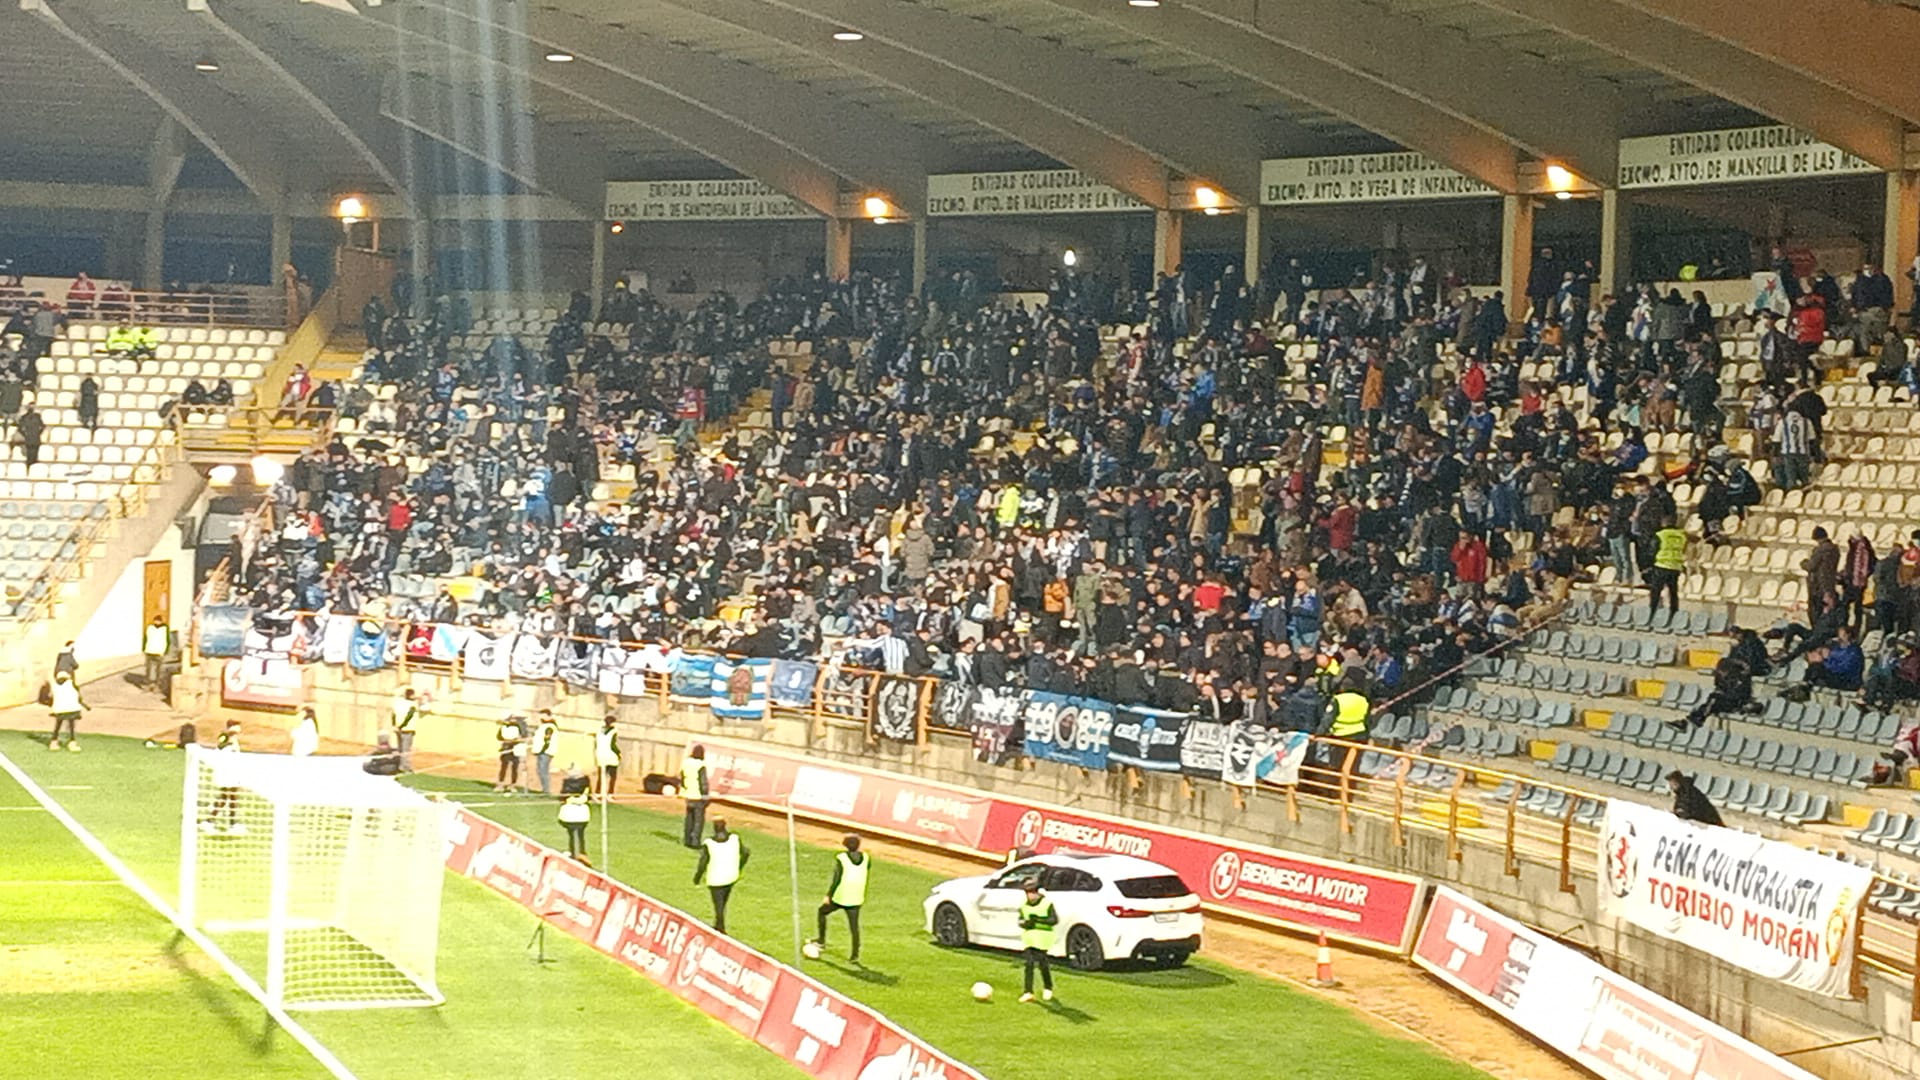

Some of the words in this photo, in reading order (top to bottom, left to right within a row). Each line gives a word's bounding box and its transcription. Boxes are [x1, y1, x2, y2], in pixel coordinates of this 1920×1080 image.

[1670, 134, 1720, 155] ENTIDAD
[1308, 158, 1354, 176] ENTIDAD
[1708, 159, 1721, 179] DE
[1727, 155, 1787, 177] MANSILLA
[1793, 153, 1808, 173] DE
[1814, 151, 1835, 171] LAS
[972, 175, 1015, 191] ENTIDAD
[1350, 180, 1363, 197] DE
[1368, 179, 1397, 196] VEGA
[1402, 178, 1415, 195] DE
[1007, 194, 1019, 211] DE
[1079, 192, 1092, 209] DE
[1096, 192, 1108, 208] LA
[1790, 423, 1800, 440] 9
[1042, 819, 1106, 850] BERNESGA
[1105, 831, 1152, 858] MOTOR
[1240, 860, 1315, 896] BERNESGA
[1314, 876, 1369, 907] MOTOR
[1702, 847, 1824, 921] CULTURALISTA
[1648, 877, 1734, 931] TORIBIO
[624, 903, 690, 956] ASPIRE
